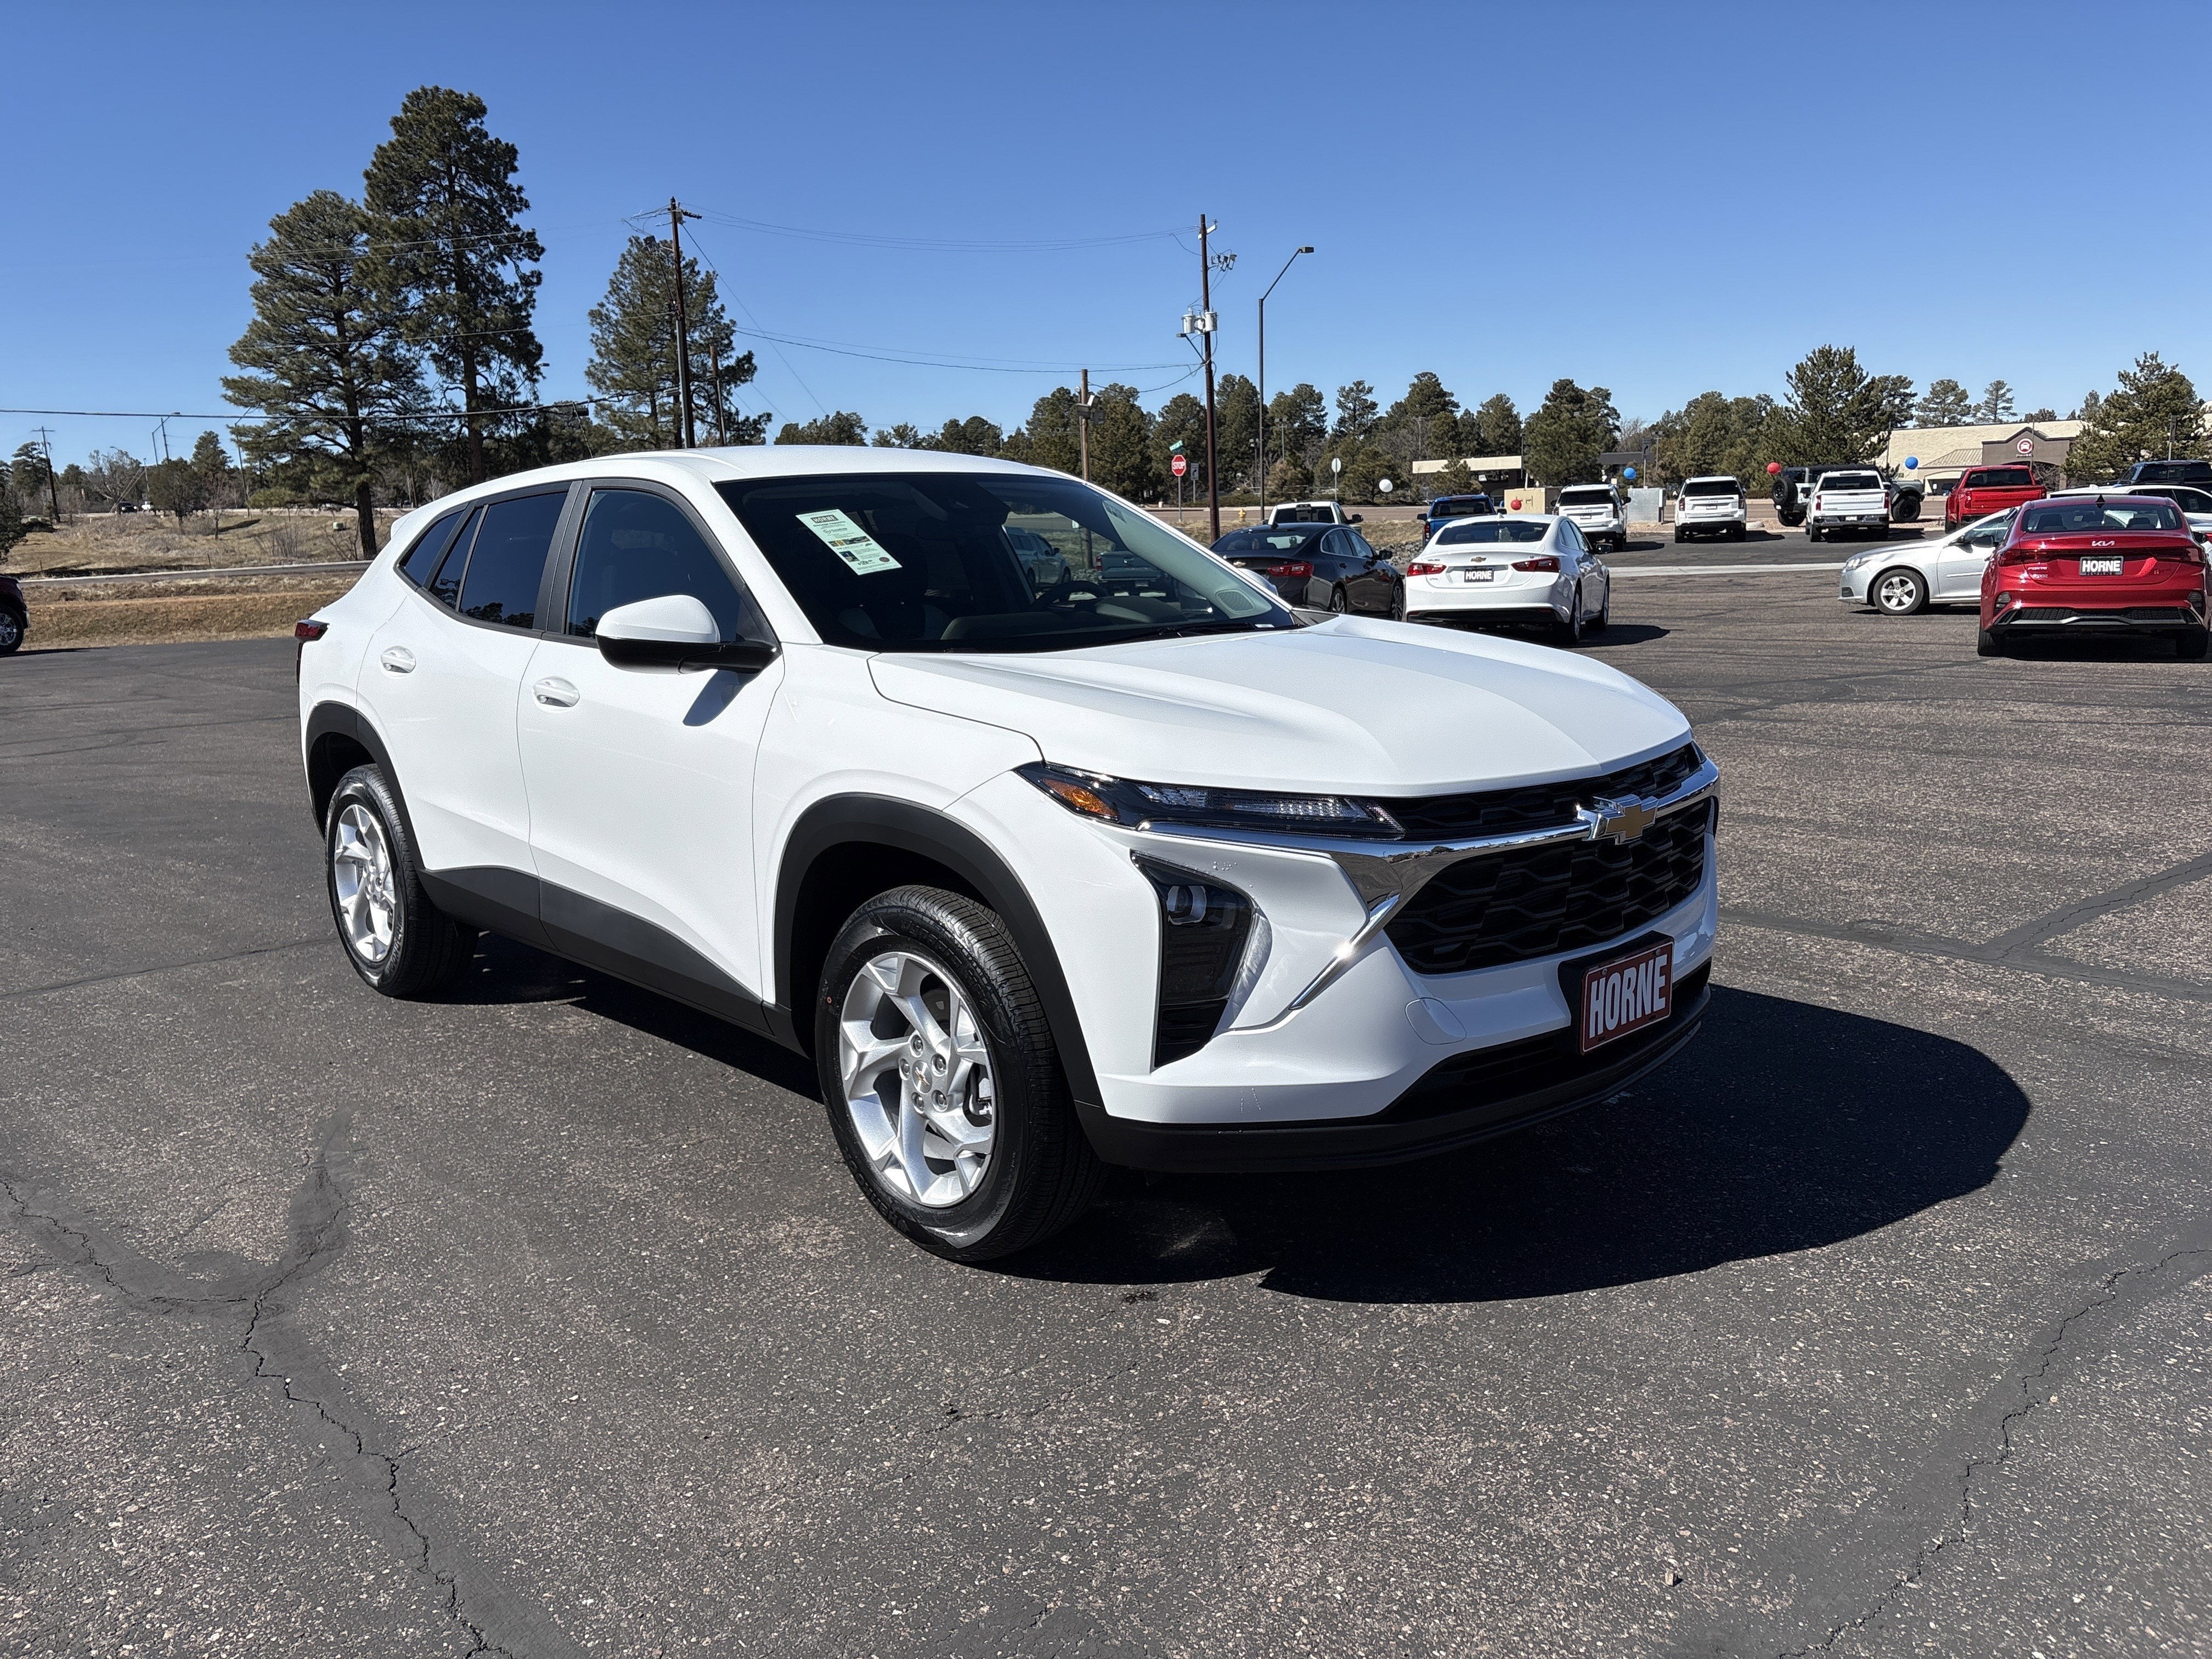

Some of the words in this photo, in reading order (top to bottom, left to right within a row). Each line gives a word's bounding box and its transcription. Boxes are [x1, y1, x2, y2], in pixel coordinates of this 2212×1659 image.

[1173, 461, 1184, 470] STOP
[2082, 560, 2121, 572] HORNE
[1465, 570, 1492, 580] HORNE
[1589, 953, 1668, 1039] HORNE
